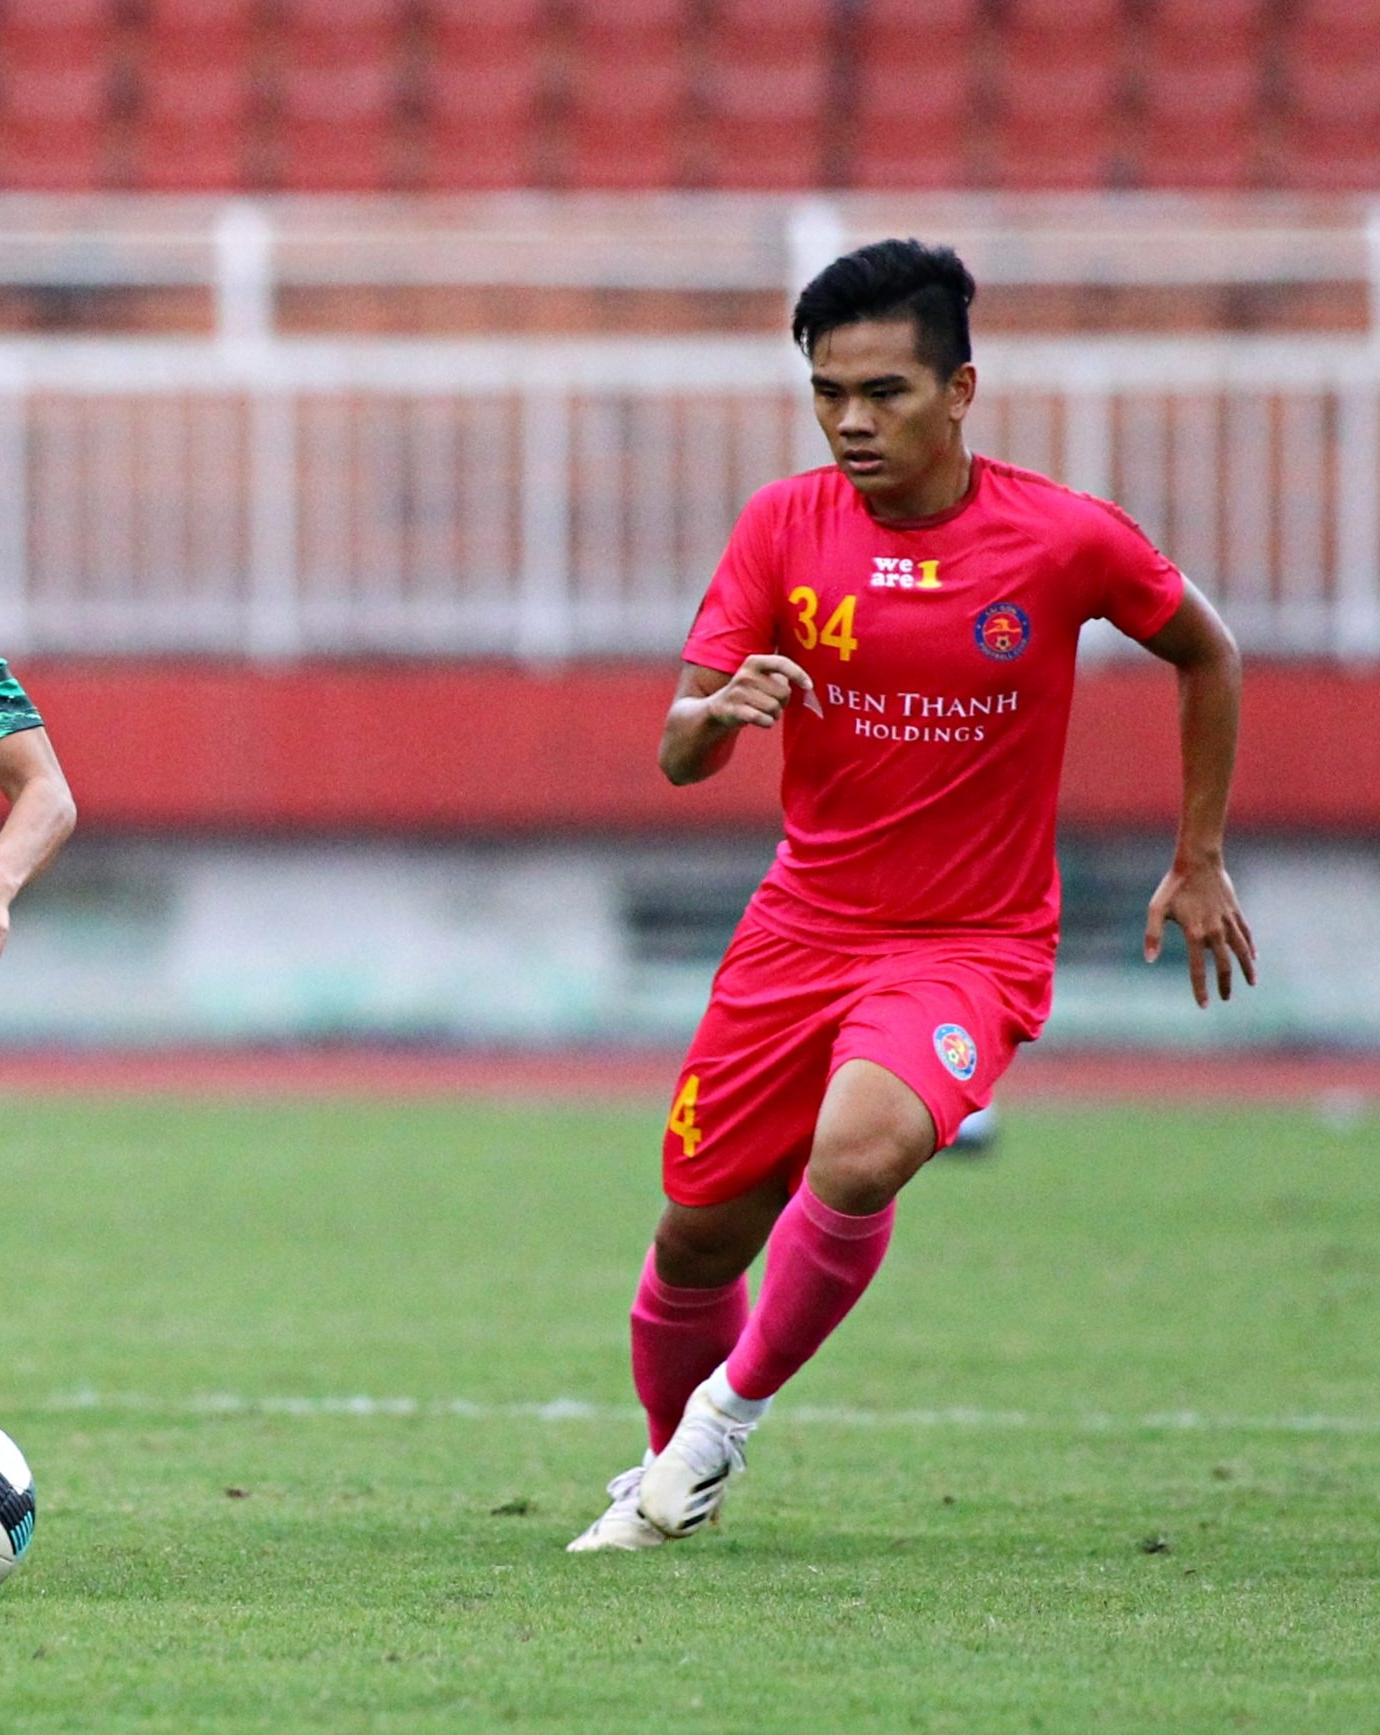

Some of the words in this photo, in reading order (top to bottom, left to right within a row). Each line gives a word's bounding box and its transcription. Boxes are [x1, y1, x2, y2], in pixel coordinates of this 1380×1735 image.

[871, 573, 914, 588] are
[916, 560, 942, 588] 1
[873, 557, 912, 572] we
[788, 586, 857, 662] 34
[827, 683, 887, 714] BEN
[897, 691, 1019, 718] THANH
[855, 718, 985, 742] HOLDINGS
[669, 1074, 701, 1158] 4
